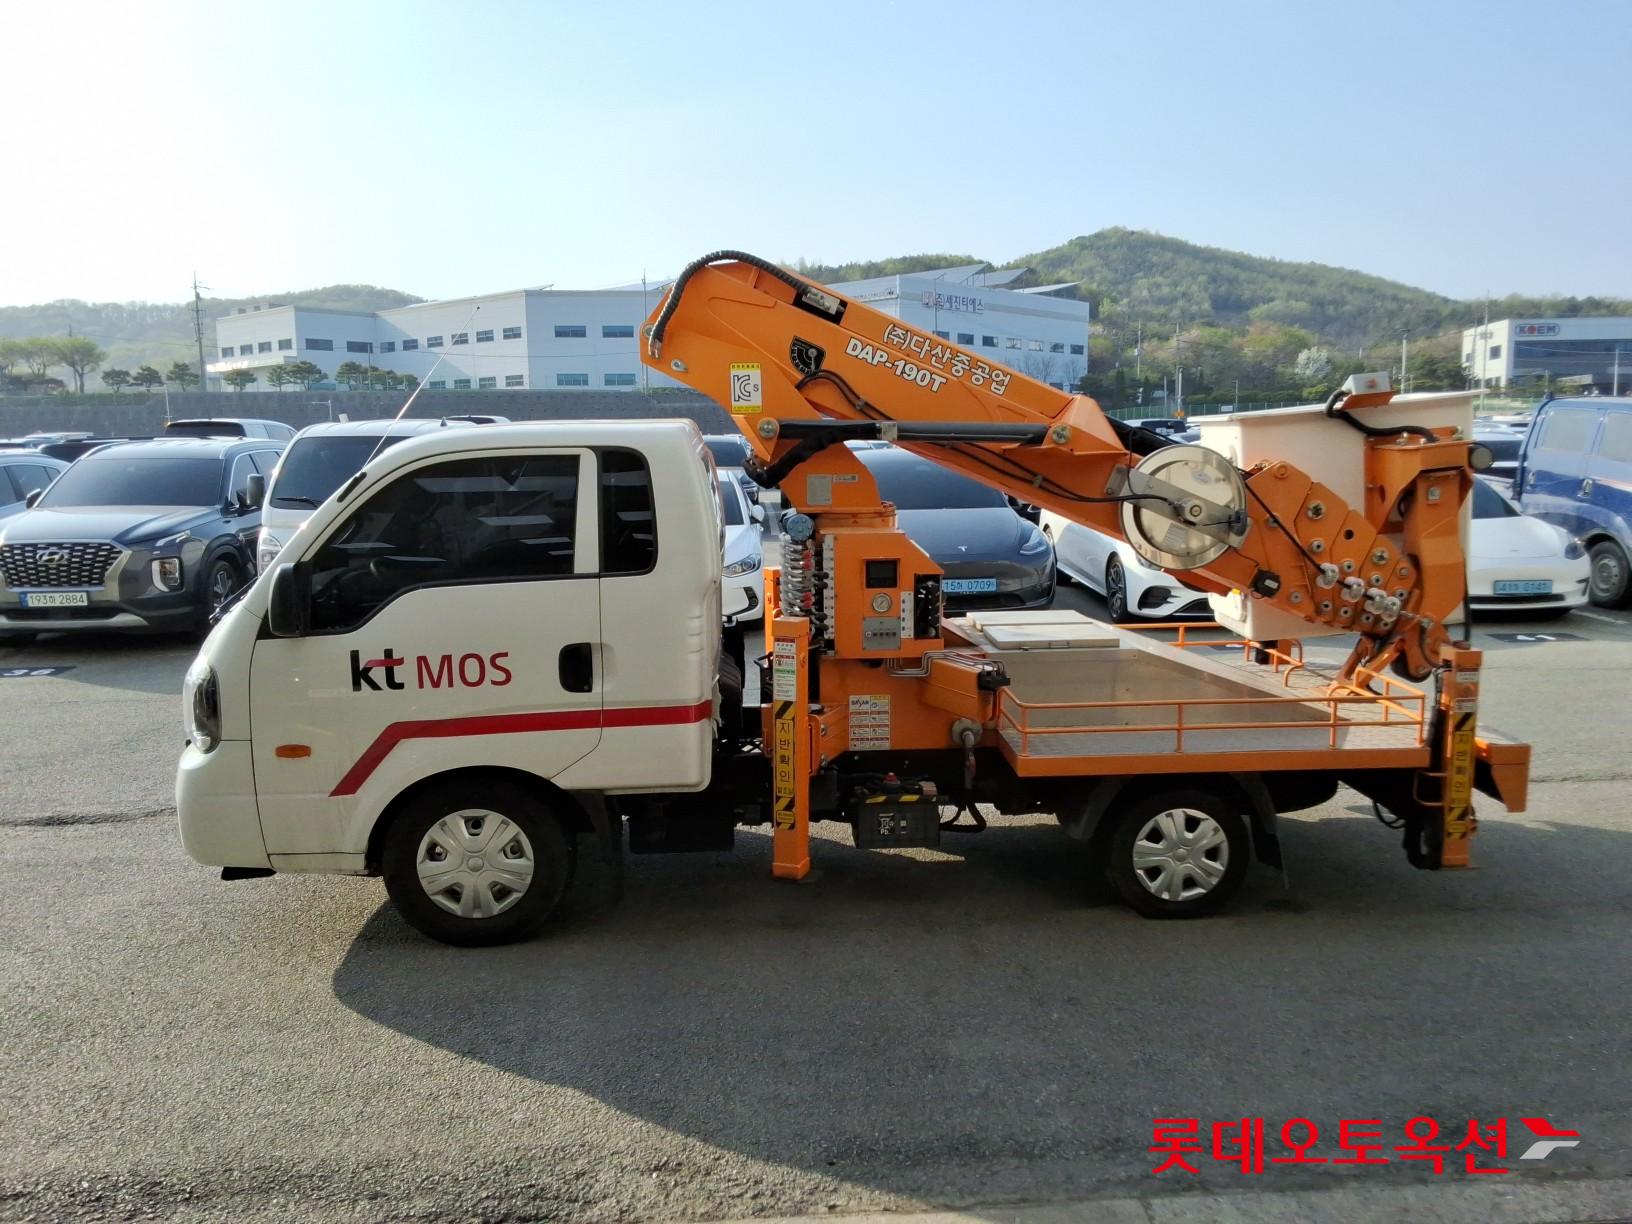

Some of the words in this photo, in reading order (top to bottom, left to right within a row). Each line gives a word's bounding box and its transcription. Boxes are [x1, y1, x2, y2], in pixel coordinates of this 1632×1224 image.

[845, 336, 947, 393] DAP-190T
[883, 323, 1012, 396] (주)다산중공업
[59, 593, 85, 605] 2884
[967, 580, 992, 590] 0709
[416, 652, 512, 689] MOS
